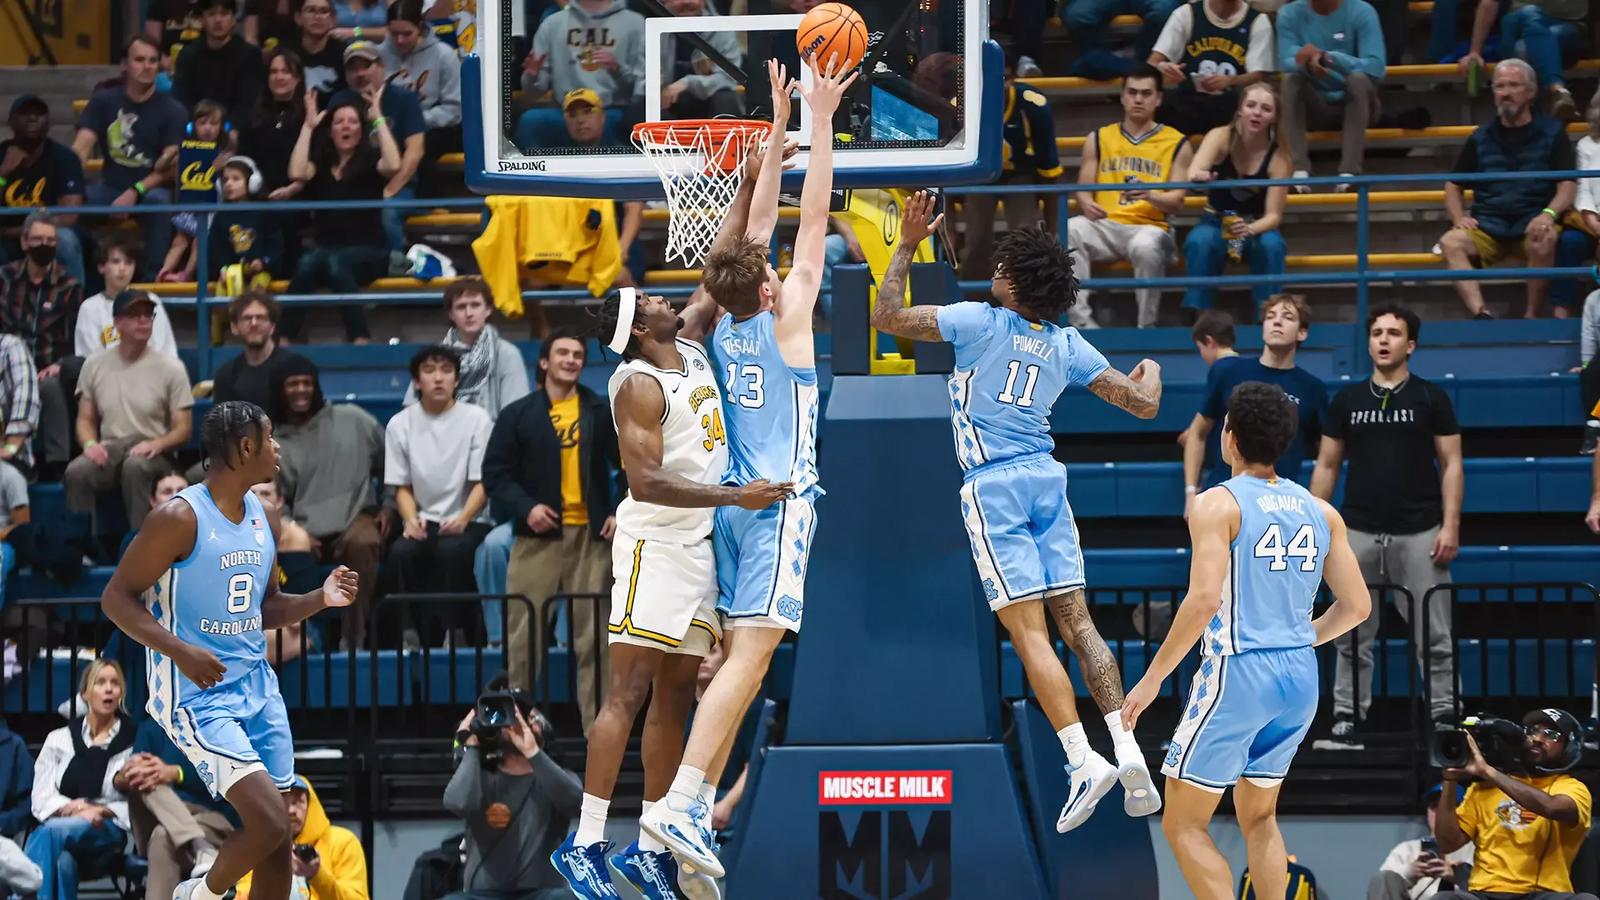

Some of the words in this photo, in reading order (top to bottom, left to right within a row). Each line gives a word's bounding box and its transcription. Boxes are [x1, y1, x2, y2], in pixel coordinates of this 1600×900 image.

[567, 27, 616, 47] CAL
[181, 160, 217, 190] Cal
[498, 160, 546, 172] SPALDING
[1013, 334, 1054, 362] POWELL
[725, 362, 765, 409] 13
[997, 359, 1041, 407] 11
[688, 385, 719, 414] BEARS
[701, 407, 726, 452] 34
[1256, 494, 1305, 516] BOGAVAC
[220, 549, 262, 571] NORTH
[1254, 522, 1319, 572] 44
[227, 572, 254, 615] 8
[823, 776, 896, 799] MUSCLE
[899, 776, 946, 798] MILK
